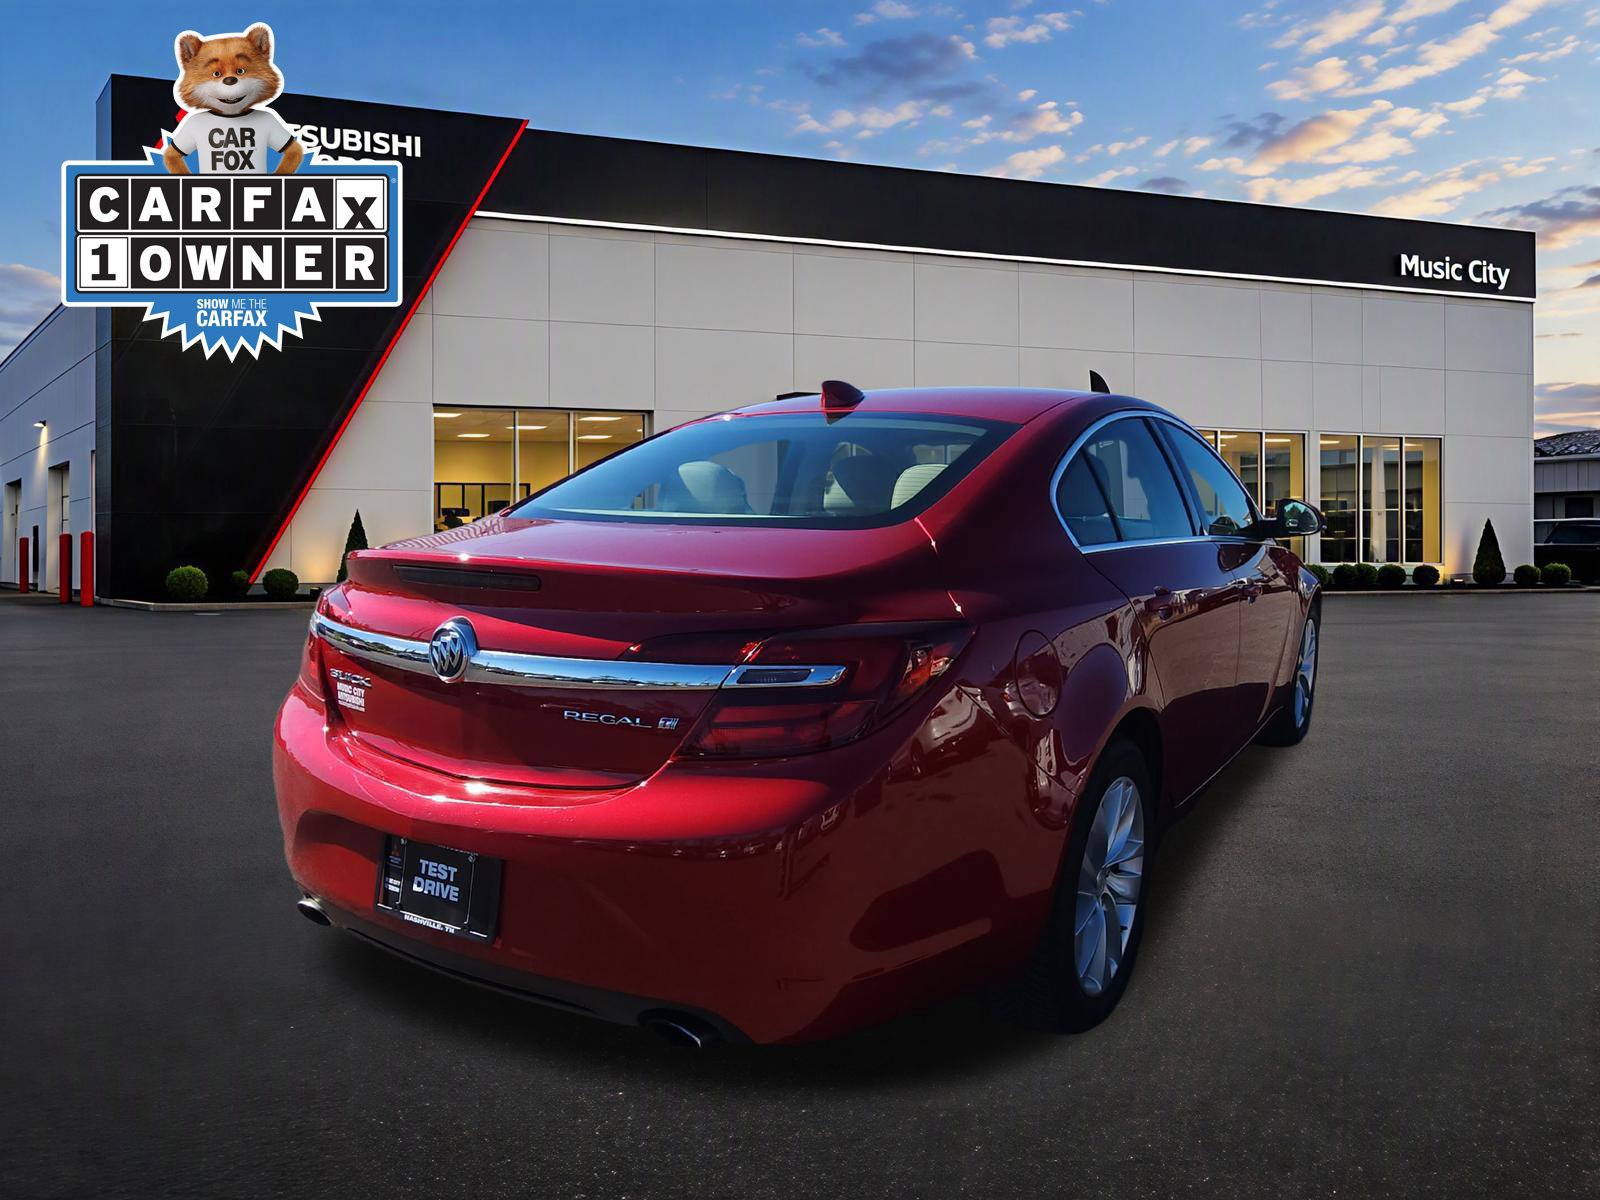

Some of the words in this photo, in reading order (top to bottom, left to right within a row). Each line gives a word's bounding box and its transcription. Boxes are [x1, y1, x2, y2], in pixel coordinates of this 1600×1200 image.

[1400, 253, 1463, 281] Music
[1468, 260, 1510, 290] City
[330, 668, 372, 687] BUICK
[563, 710, 653, 728] REGAL
[419, 858, 457, 882] TEST
[412, 876, 460, 902] DRIVE
[444, 926, 455, 934] TN
